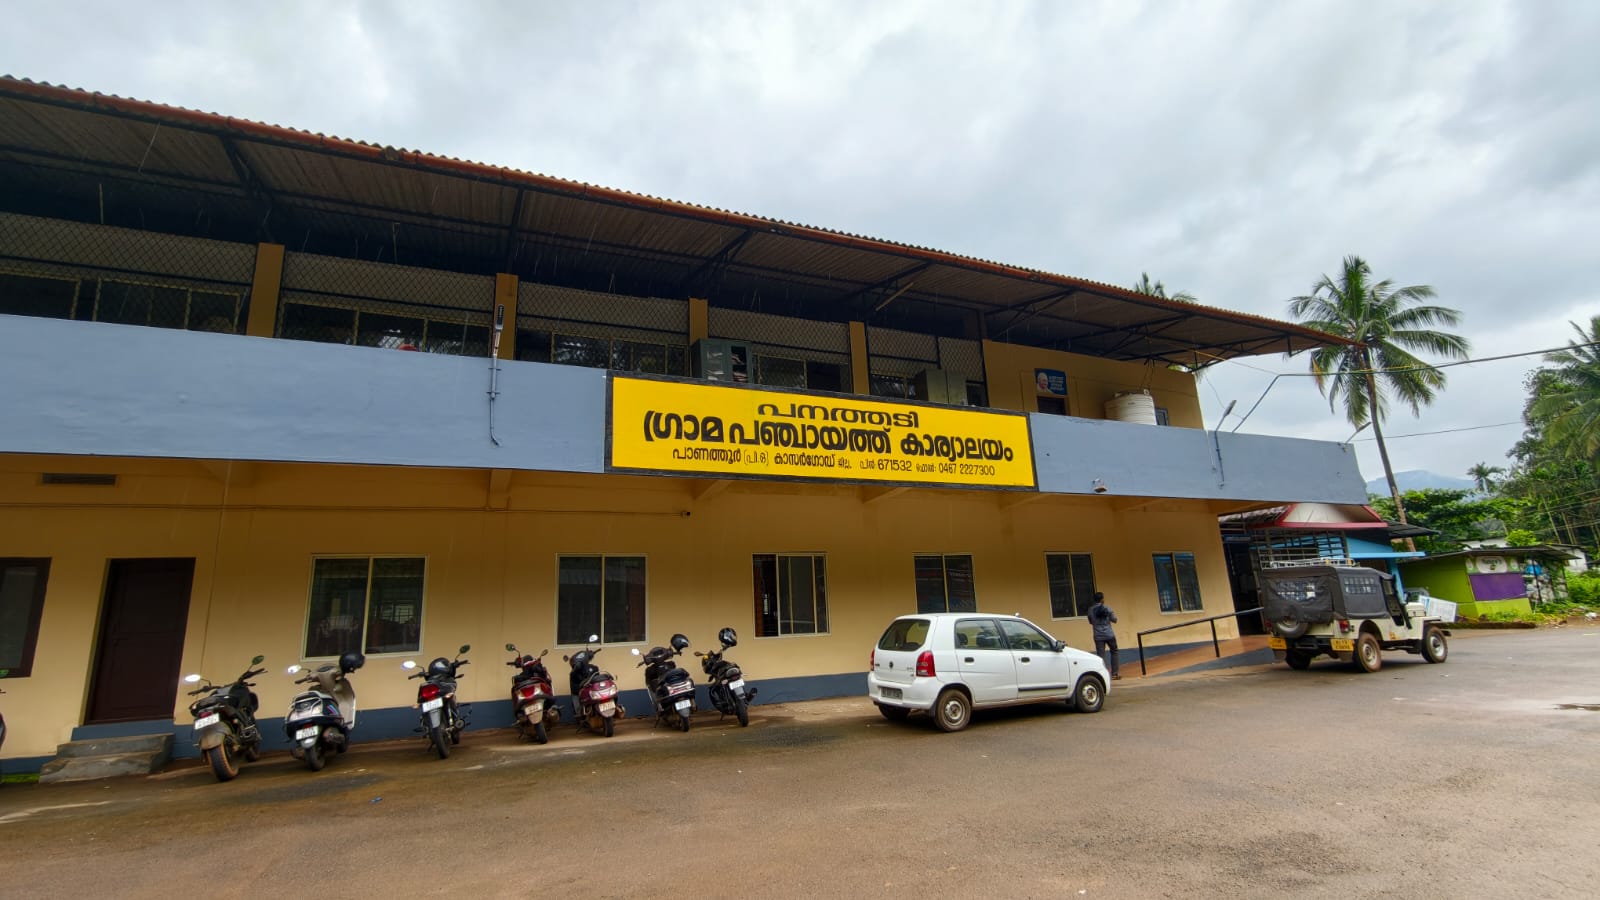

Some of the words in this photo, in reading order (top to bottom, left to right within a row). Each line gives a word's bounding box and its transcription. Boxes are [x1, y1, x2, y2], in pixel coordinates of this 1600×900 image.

[757, 403, 919, 428] പനത്തടി
[900, 433, 1013, 462] കാര്യാലയം
[877, 458, 912, 472] 671532
[938, 463, 957, 475] 0467
[959, 464, 996, 477] 2227300
